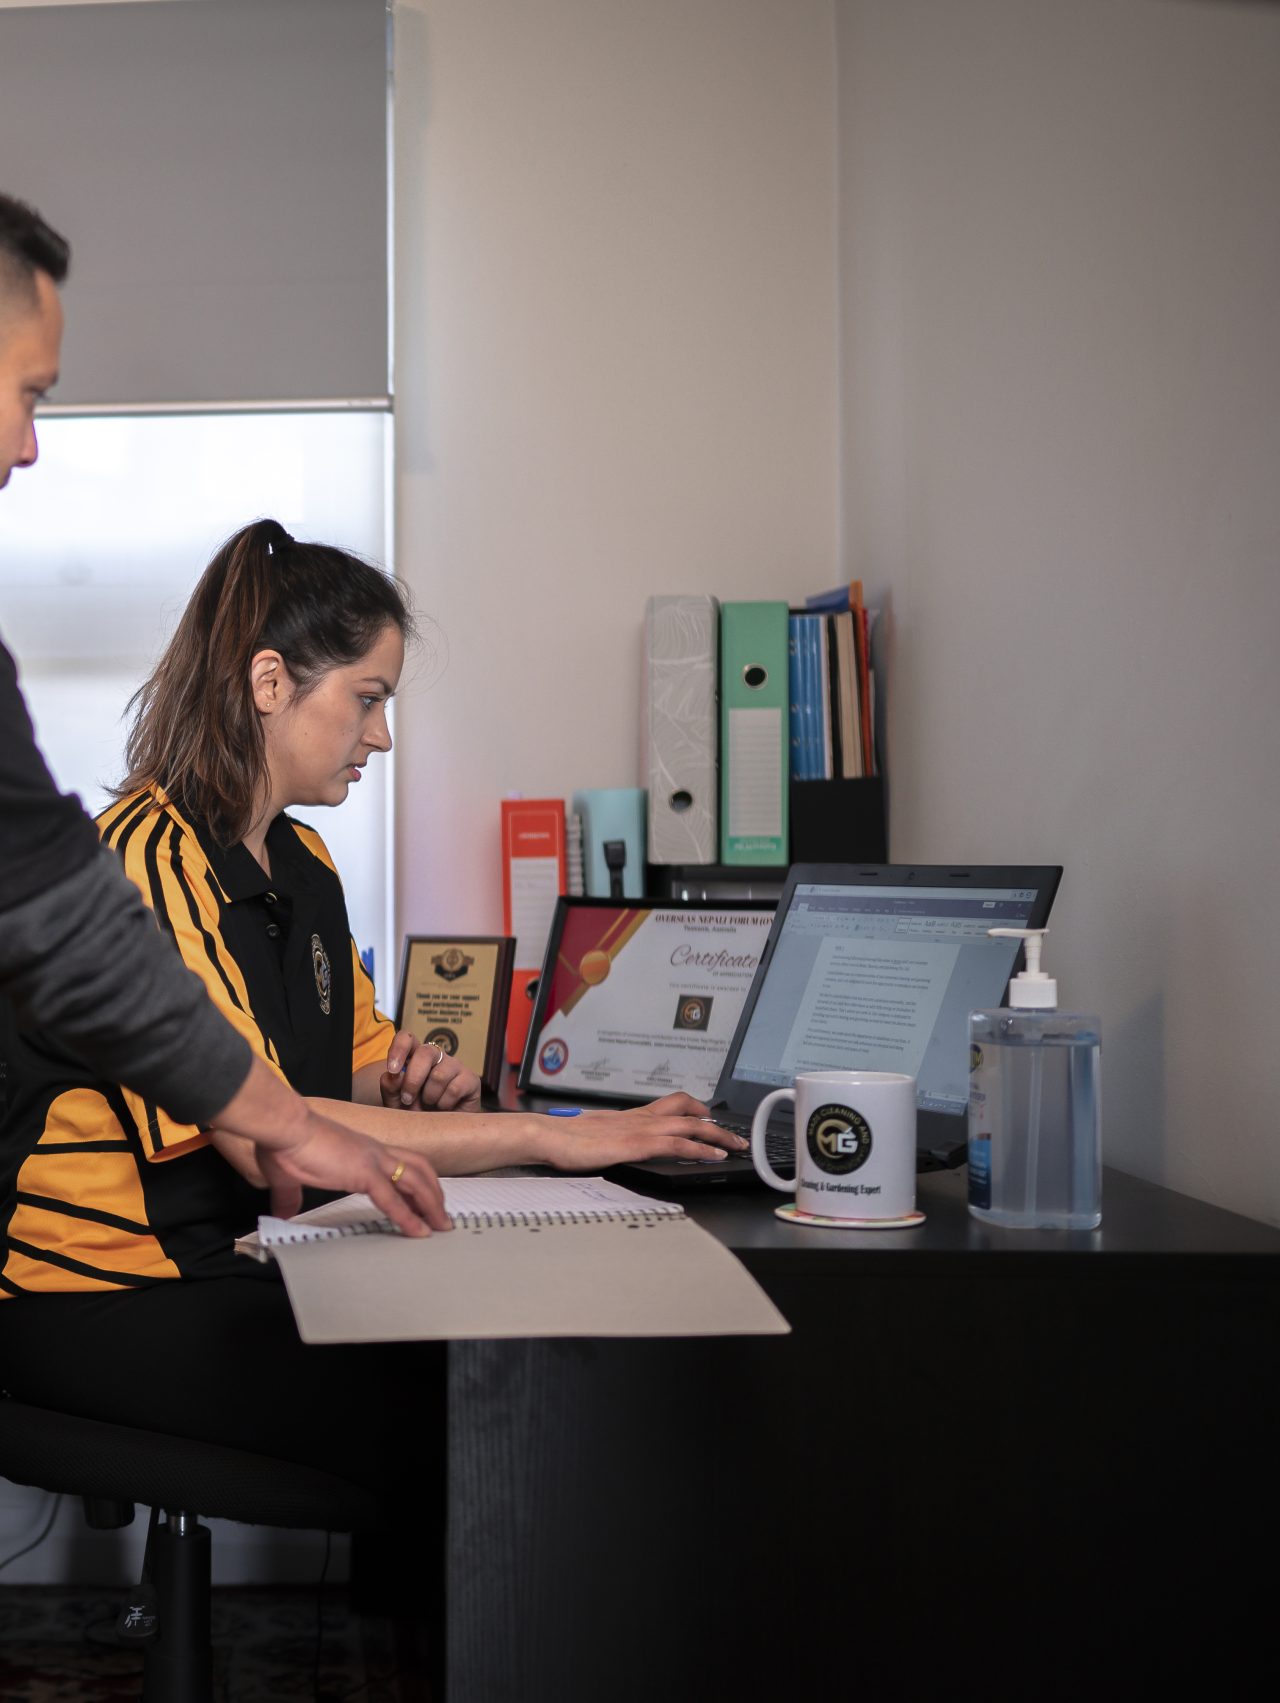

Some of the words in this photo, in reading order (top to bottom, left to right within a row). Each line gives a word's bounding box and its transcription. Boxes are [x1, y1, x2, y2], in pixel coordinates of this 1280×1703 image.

[670, 943, 759, 972] Certificate
[826, 1183, 859, 1196] Gardening
[860, 1184, 882, 1196] Expert
